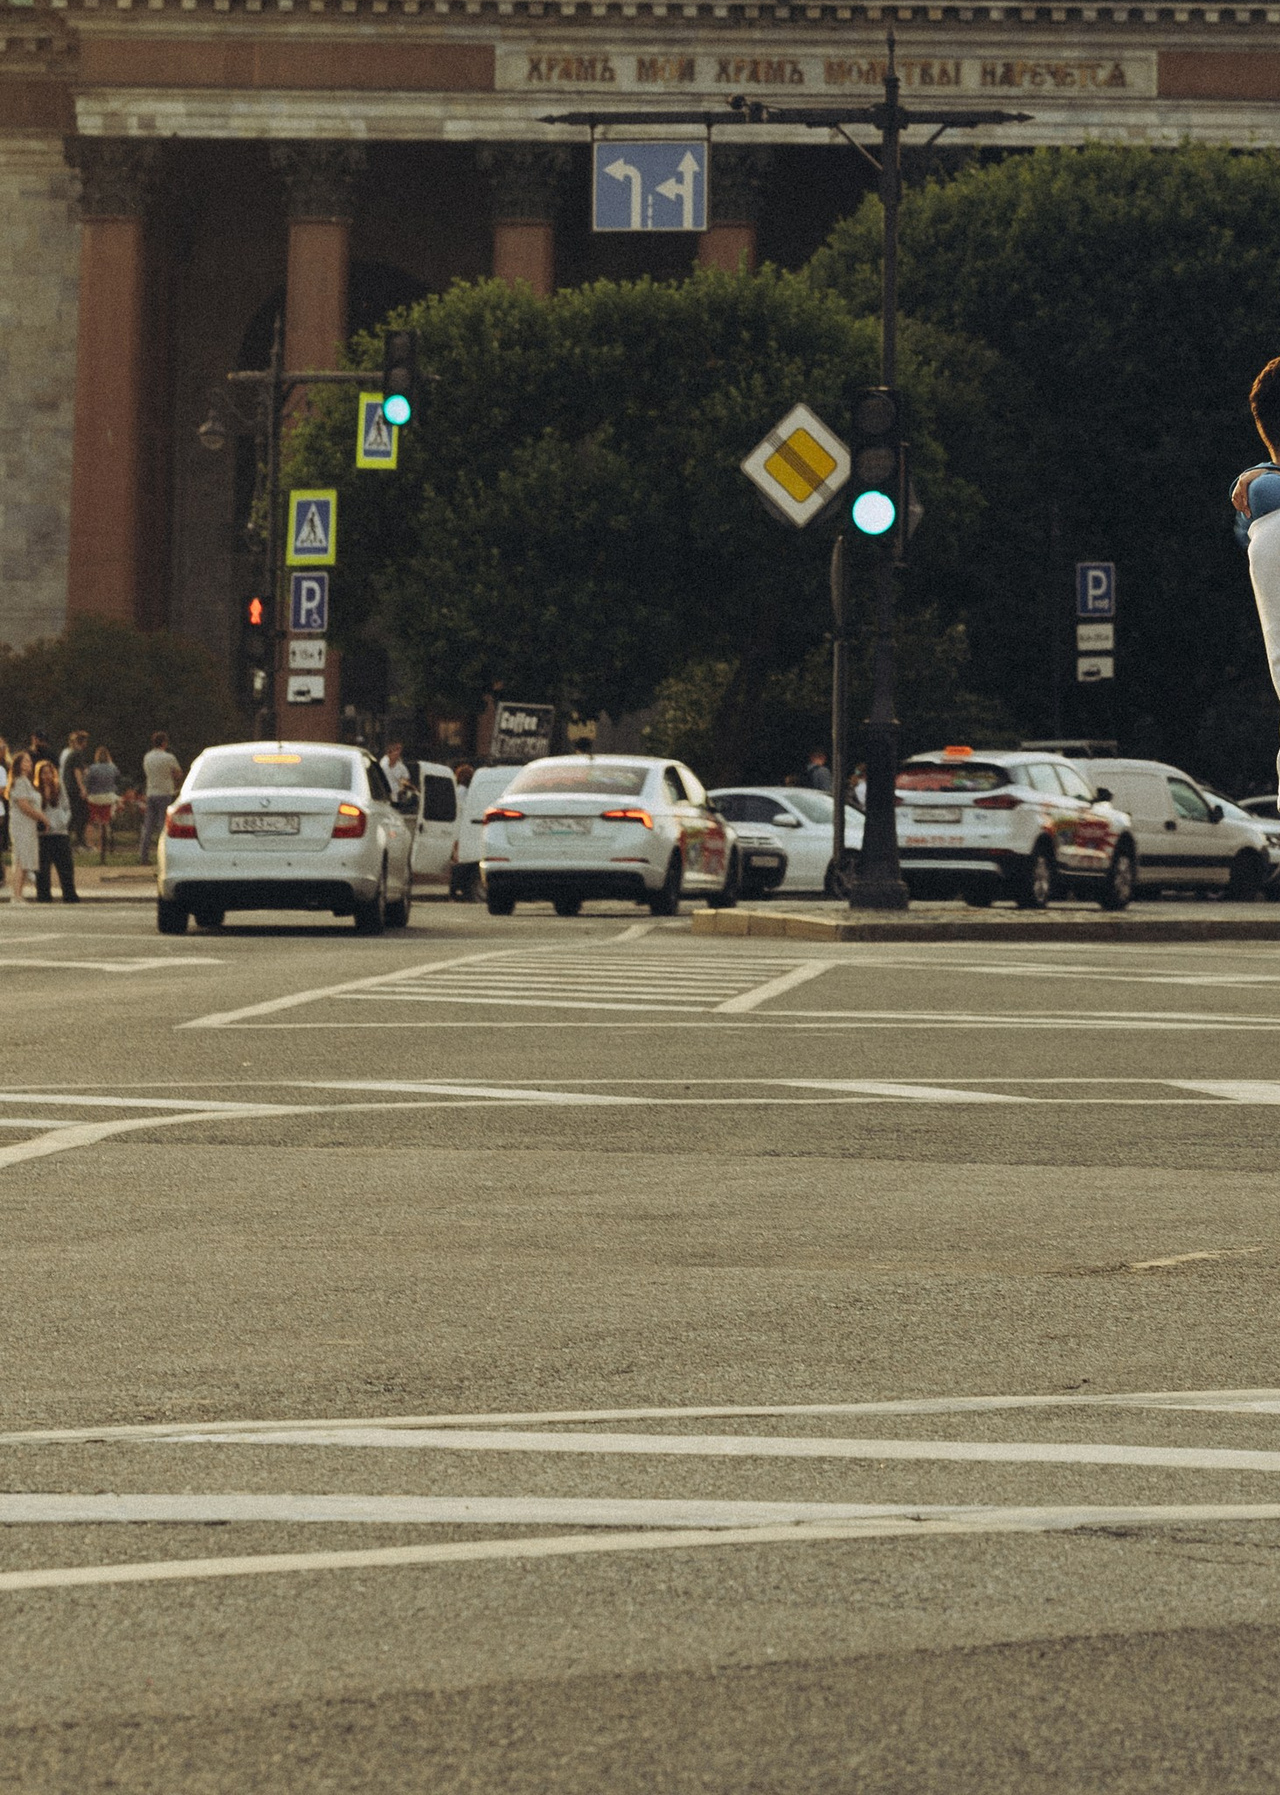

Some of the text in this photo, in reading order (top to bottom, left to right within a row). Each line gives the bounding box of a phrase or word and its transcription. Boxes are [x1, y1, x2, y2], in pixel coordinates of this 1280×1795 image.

[527, 55, 616, 83] ХРАМЪ
[715, 56, 805, 84] ХРАМЪ
[300, 580, 322, 624] P
